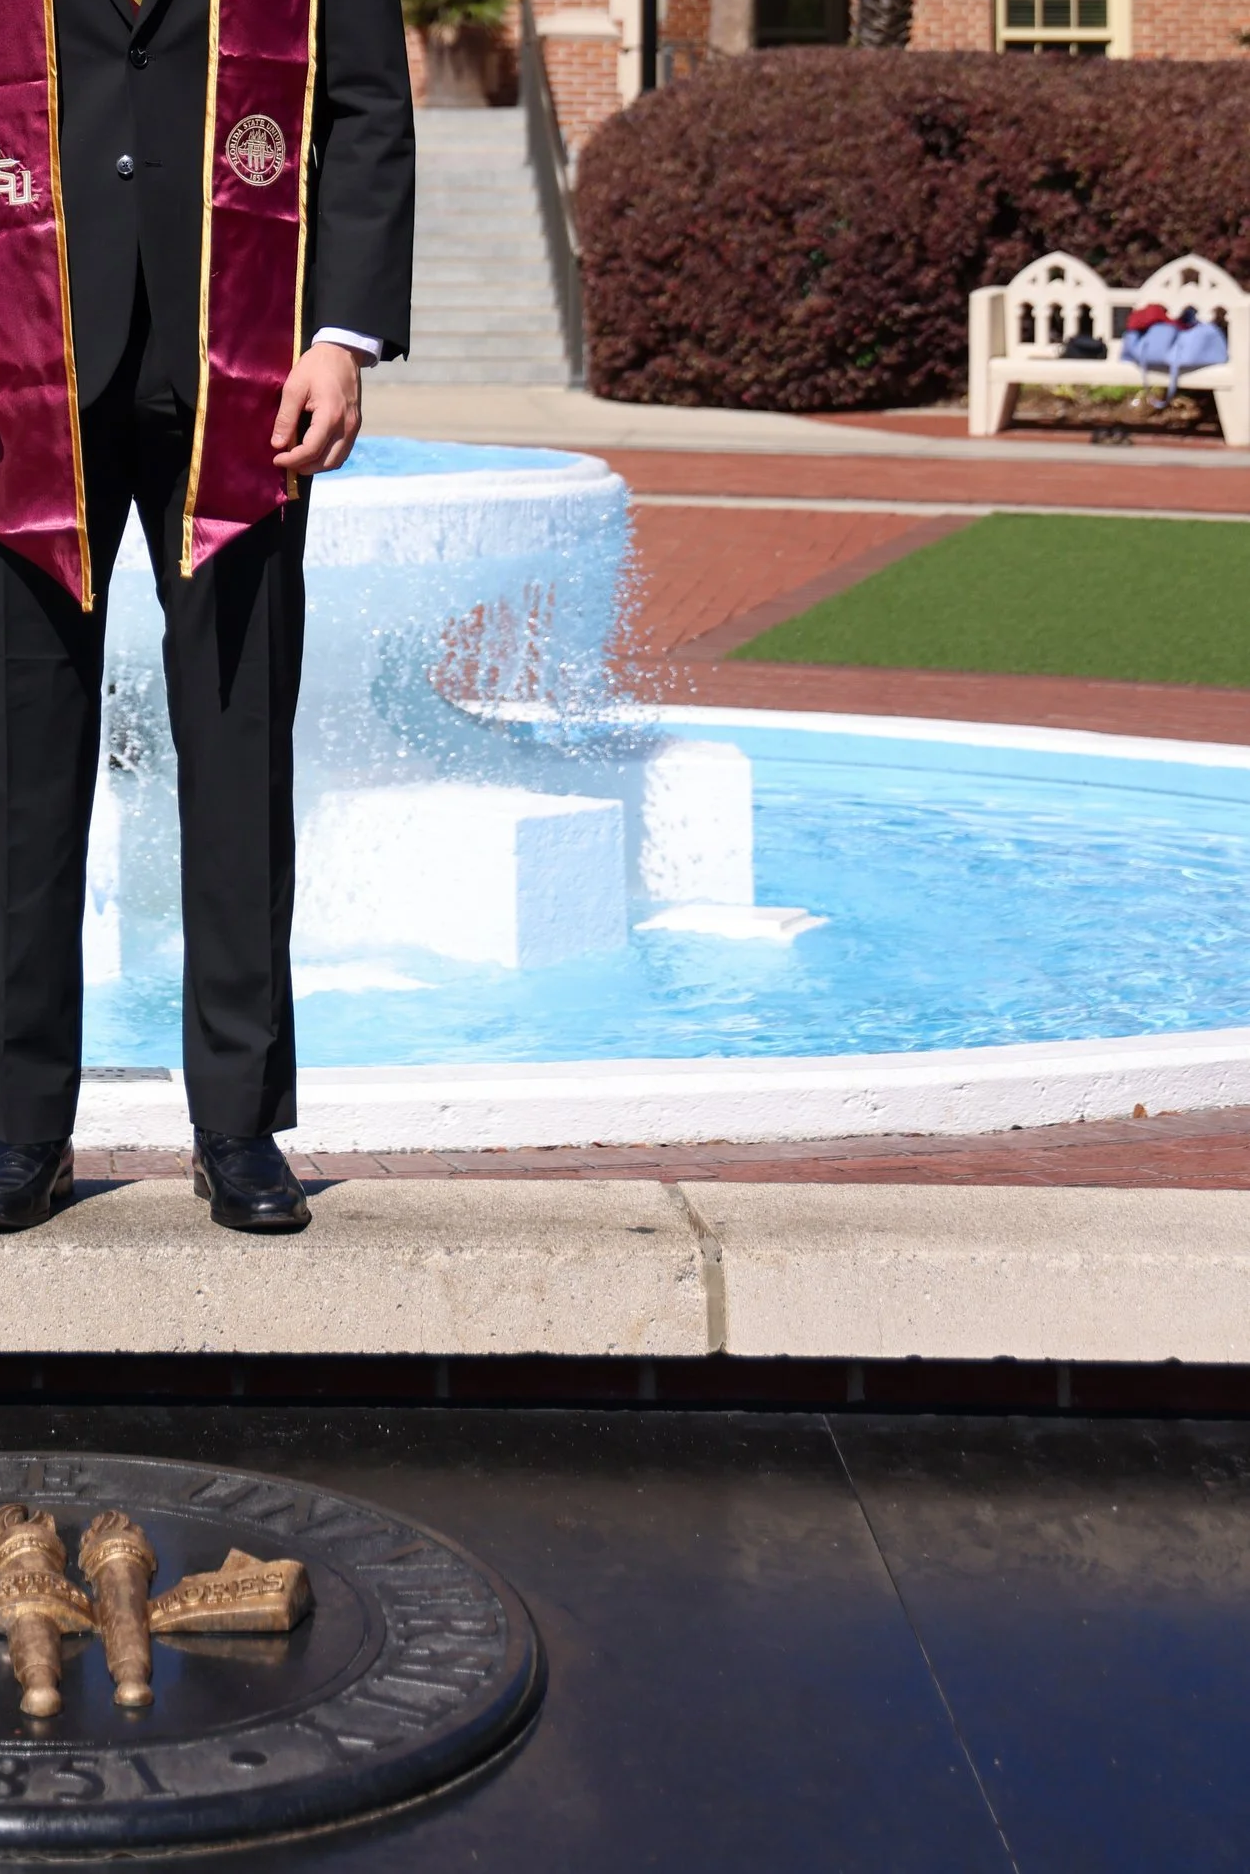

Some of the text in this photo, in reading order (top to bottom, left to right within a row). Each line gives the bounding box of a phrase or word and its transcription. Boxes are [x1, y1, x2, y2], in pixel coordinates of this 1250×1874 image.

[229, 118, 283, 172] FLORIDA STATE UNIVERSITY
[249, 173, 264, 182] 1851
